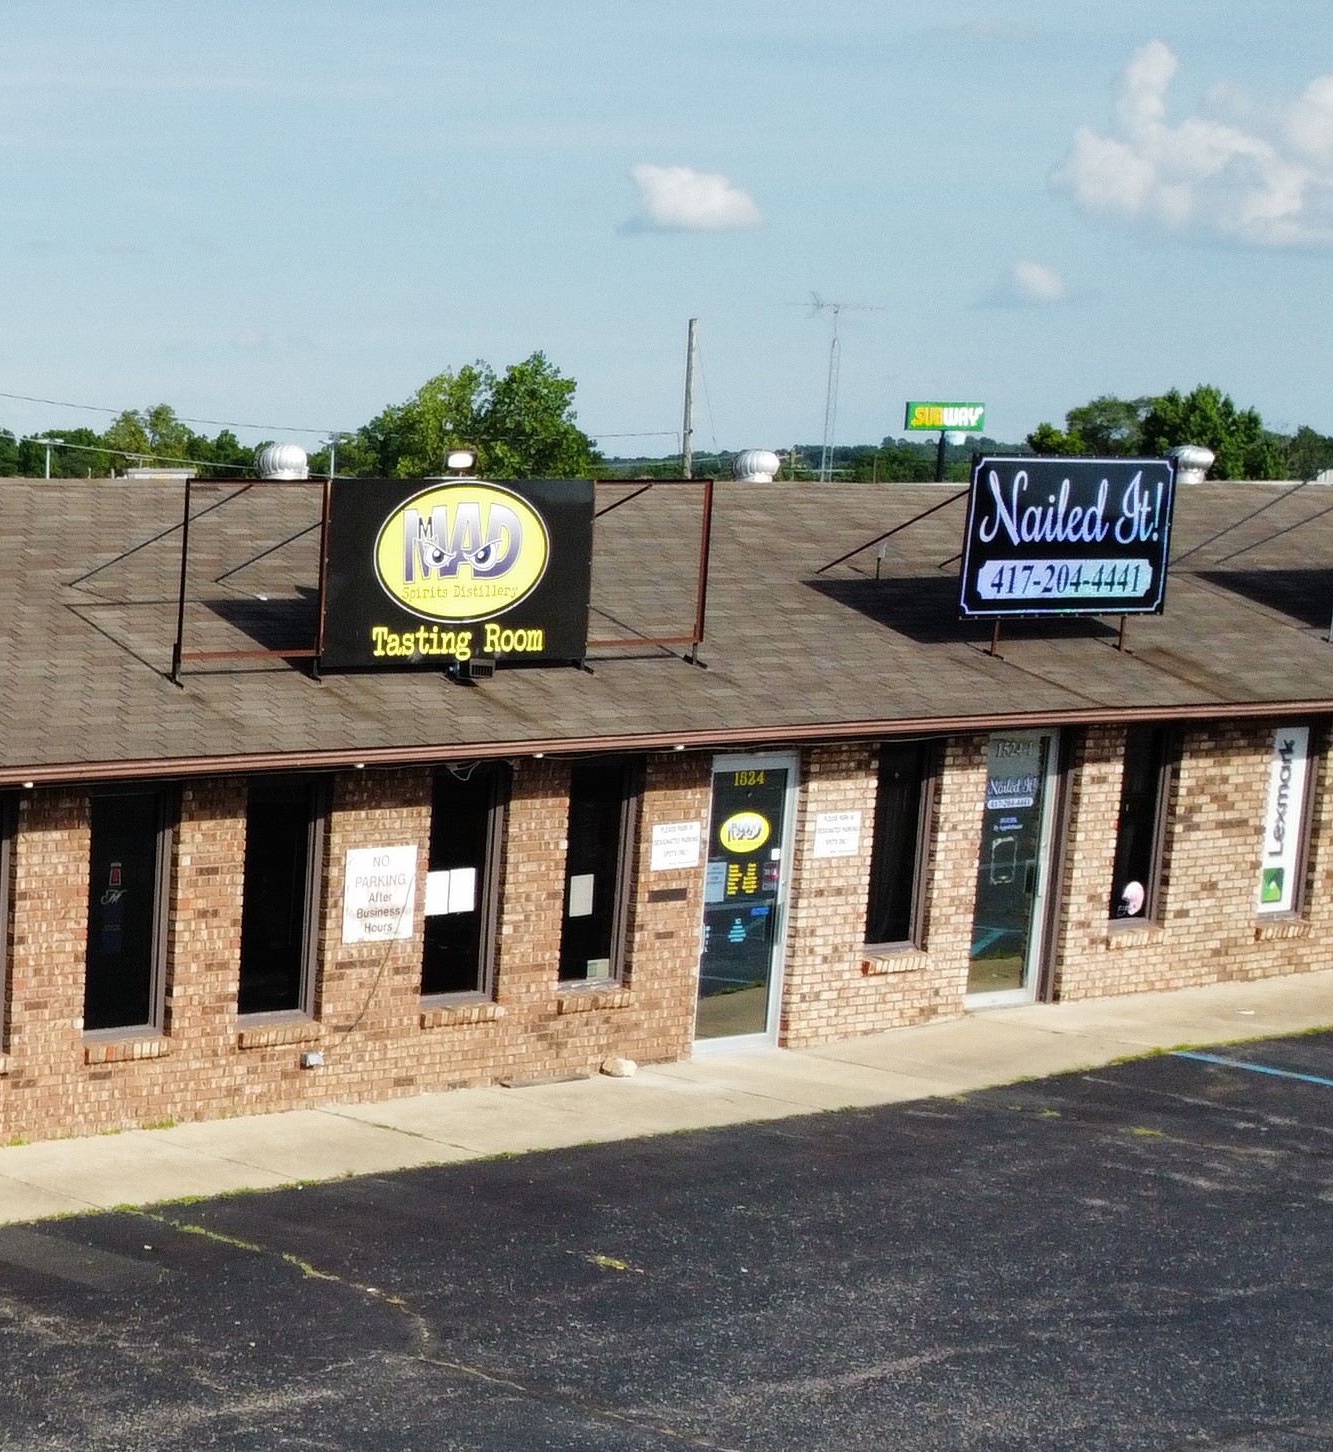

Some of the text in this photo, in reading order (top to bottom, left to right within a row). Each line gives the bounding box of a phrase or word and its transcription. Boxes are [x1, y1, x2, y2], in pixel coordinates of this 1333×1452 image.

[911, 406, 984, 427] SUBWAY
[979, 470, 1164, 546] Nailed It!
[404, 502, 523, 585] MAD
[989, 563, 1142, 595] 417-204-4441
[402, 584, 519, 602] Spirits Distillery
[372, 624, 544, 661] Tasting Room
[734, 771, 766, 787] 1524
[988, 778, 1020, 796] Nailed
[1269, 739, 1296, 857] Lexmark
[373, 855, 390, 867] NO
[355, 873, 406, 888] PARKING
[368, 892, 392, 903] After
[356, 908, 401, 919] Business
[364, 923, 393, 933] Hours
